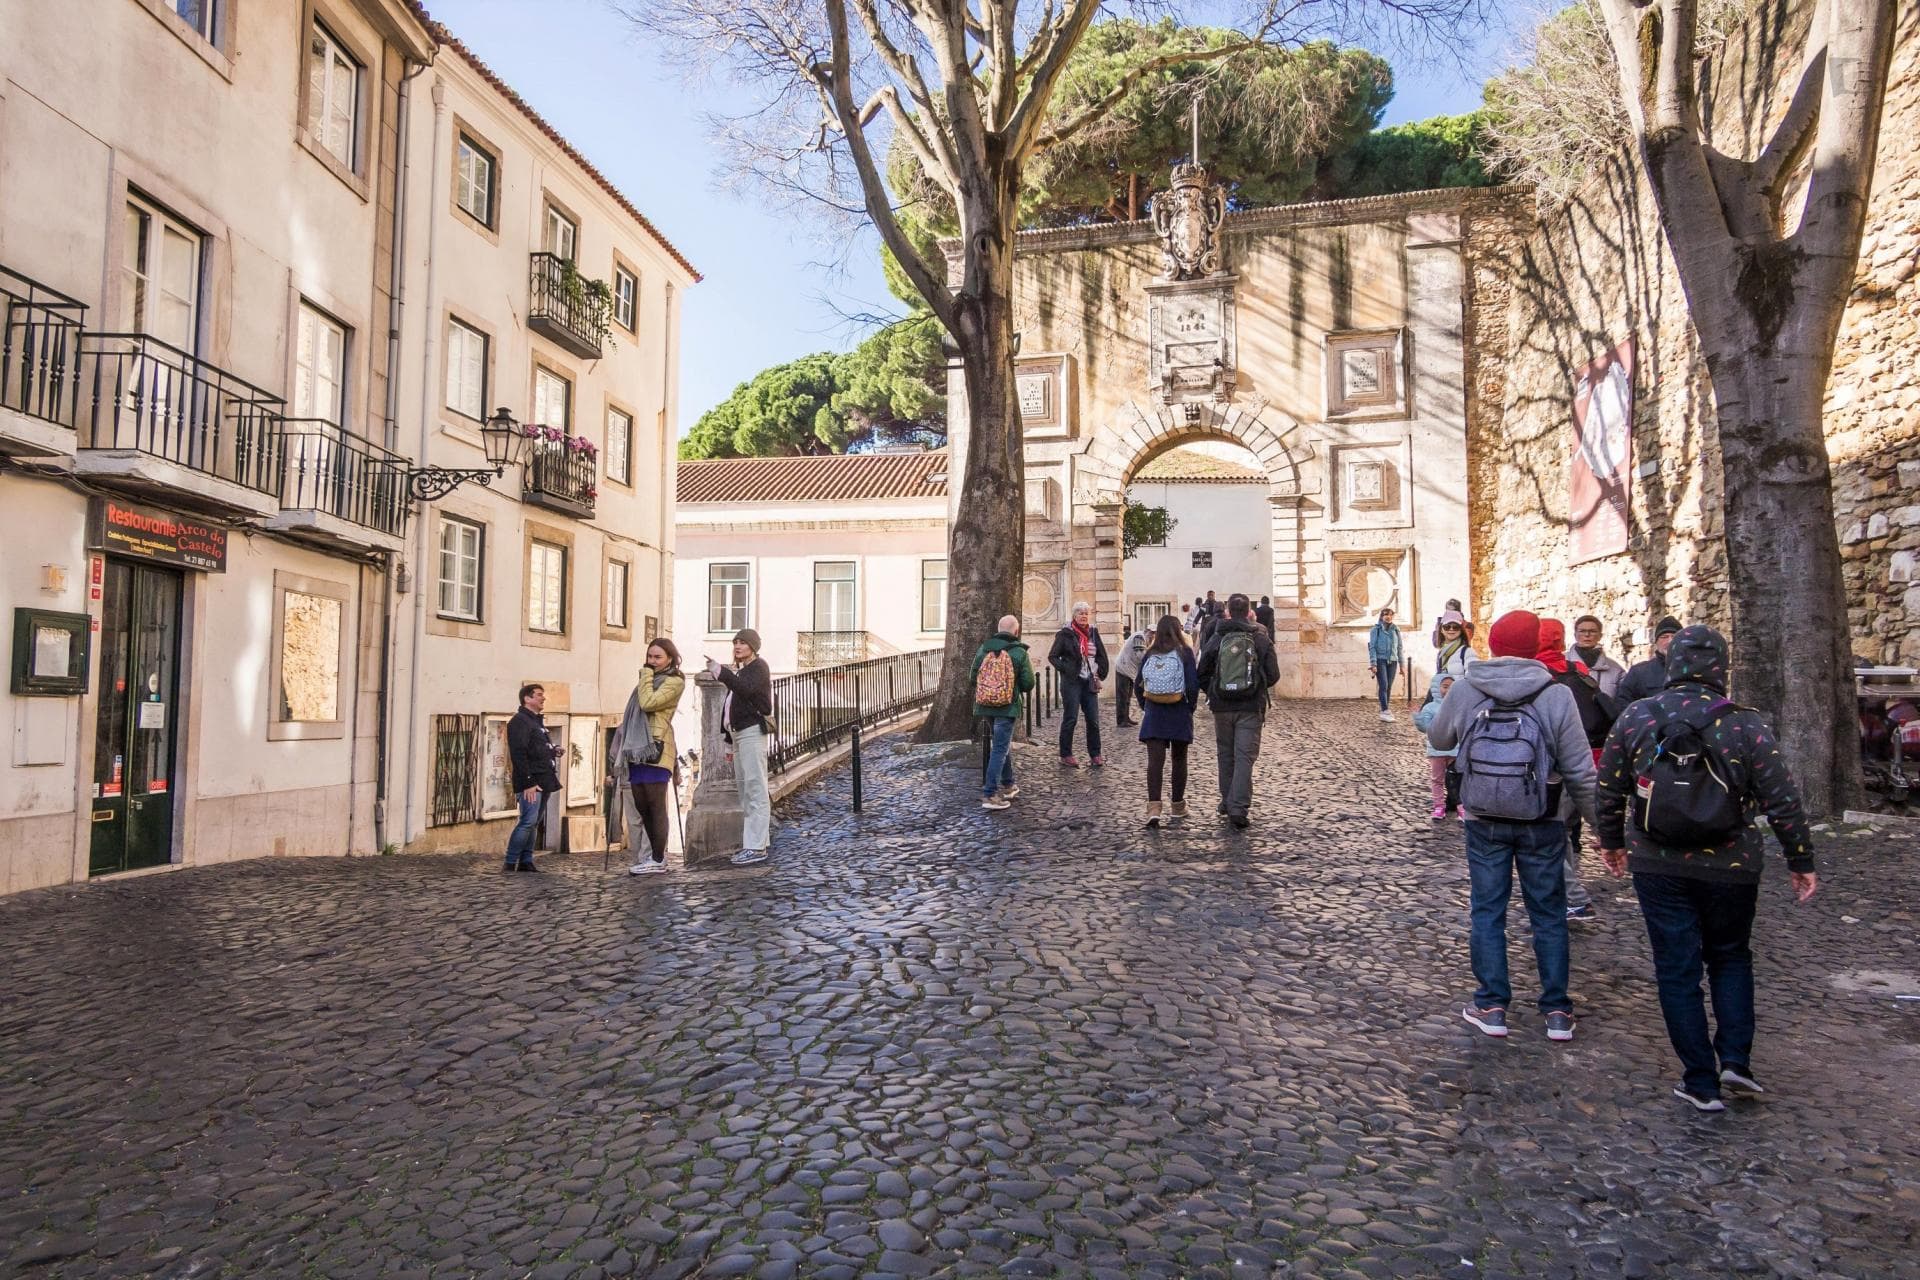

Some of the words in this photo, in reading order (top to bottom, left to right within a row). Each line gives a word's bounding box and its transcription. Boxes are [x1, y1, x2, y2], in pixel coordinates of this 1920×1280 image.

[108, 503, 177, 537] Restaurante
[177, 522, 207, 537] Arco
[210, 529, 224, 545] do
[178, 536, 223, 559] Castelo
